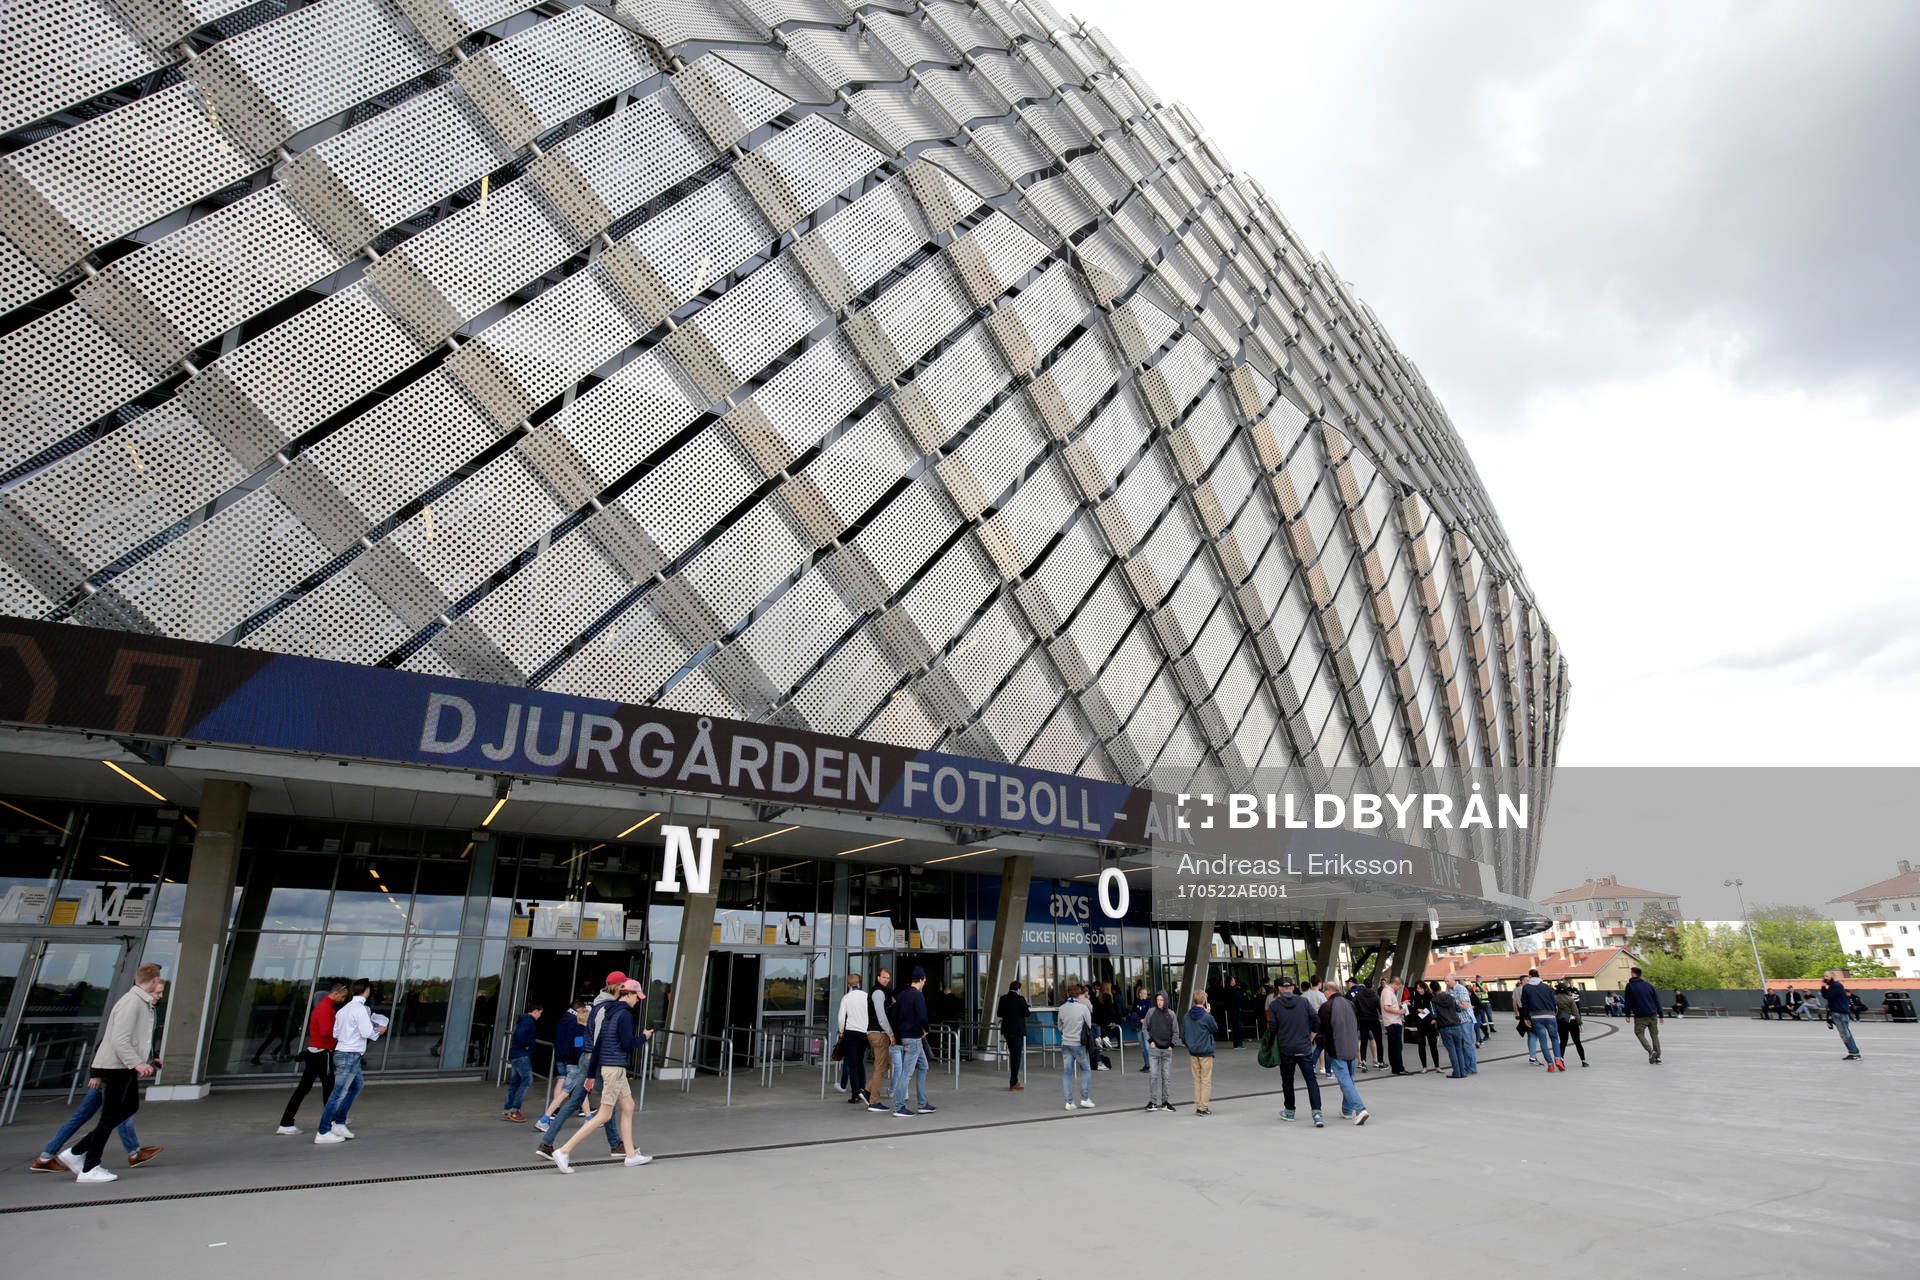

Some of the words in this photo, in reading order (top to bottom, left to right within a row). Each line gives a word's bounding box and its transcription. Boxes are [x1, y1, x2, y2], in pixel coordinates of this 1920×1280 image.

[420, 692, 881, 804] DJURGÅRDEN
[903, 760, 1101, 832] FOTBOLL
[1144, 800, 1195, 845] AIK
[655, 824, 721, 894] N
[1049, 894, 1090, 923] axs
[1058, 932, 1083, 945] INFO
[1085, 930, 1118, 946] SÖDER
